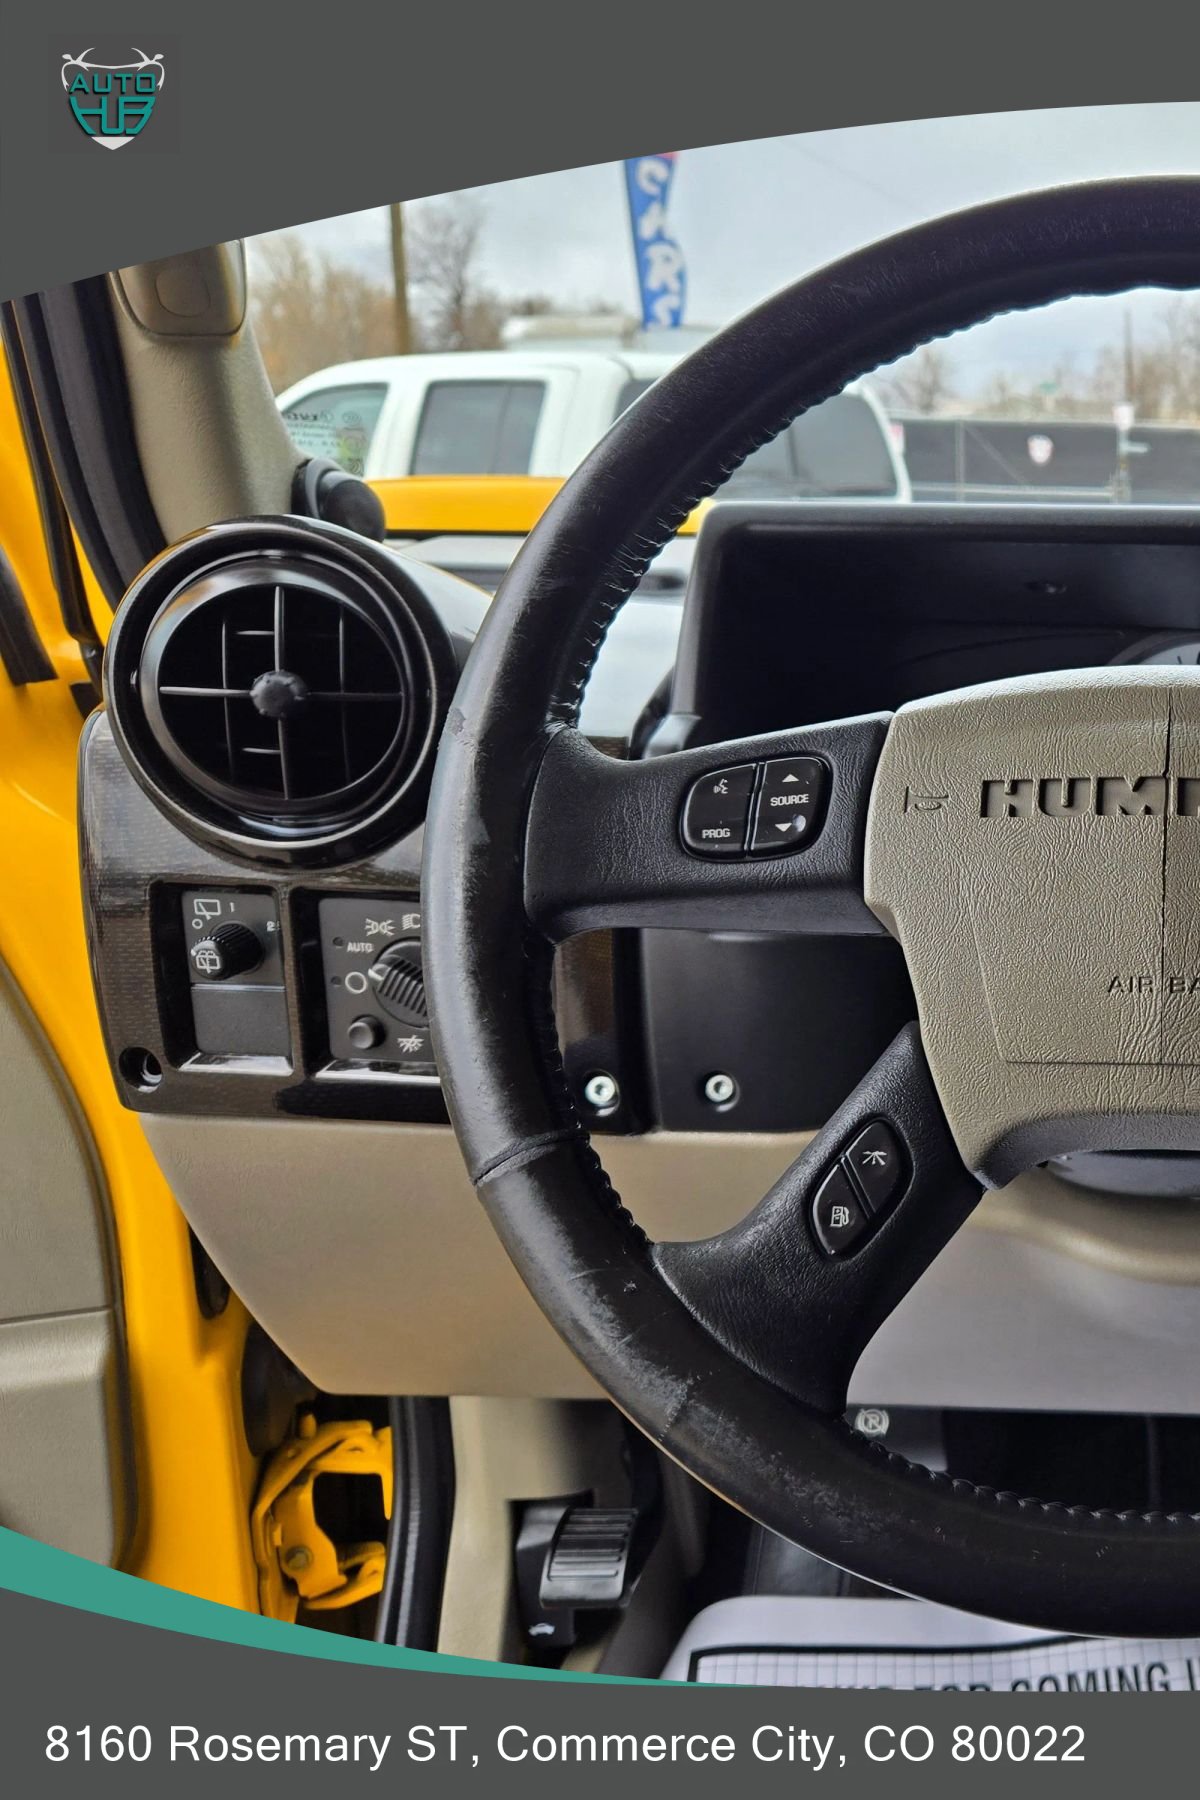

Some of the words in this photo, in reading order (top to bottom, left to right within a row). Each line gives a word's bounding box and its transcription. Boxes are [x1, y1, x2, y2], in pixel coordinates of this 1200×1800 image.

[770, 794, 809, 806] SOURCE
[701, 828, 731, 838] PROG
[346, 942, 374, 953] AUTO
[1107, 976, 1153, 994] AIR
[1011, 1661, 1171, 1691] MING
